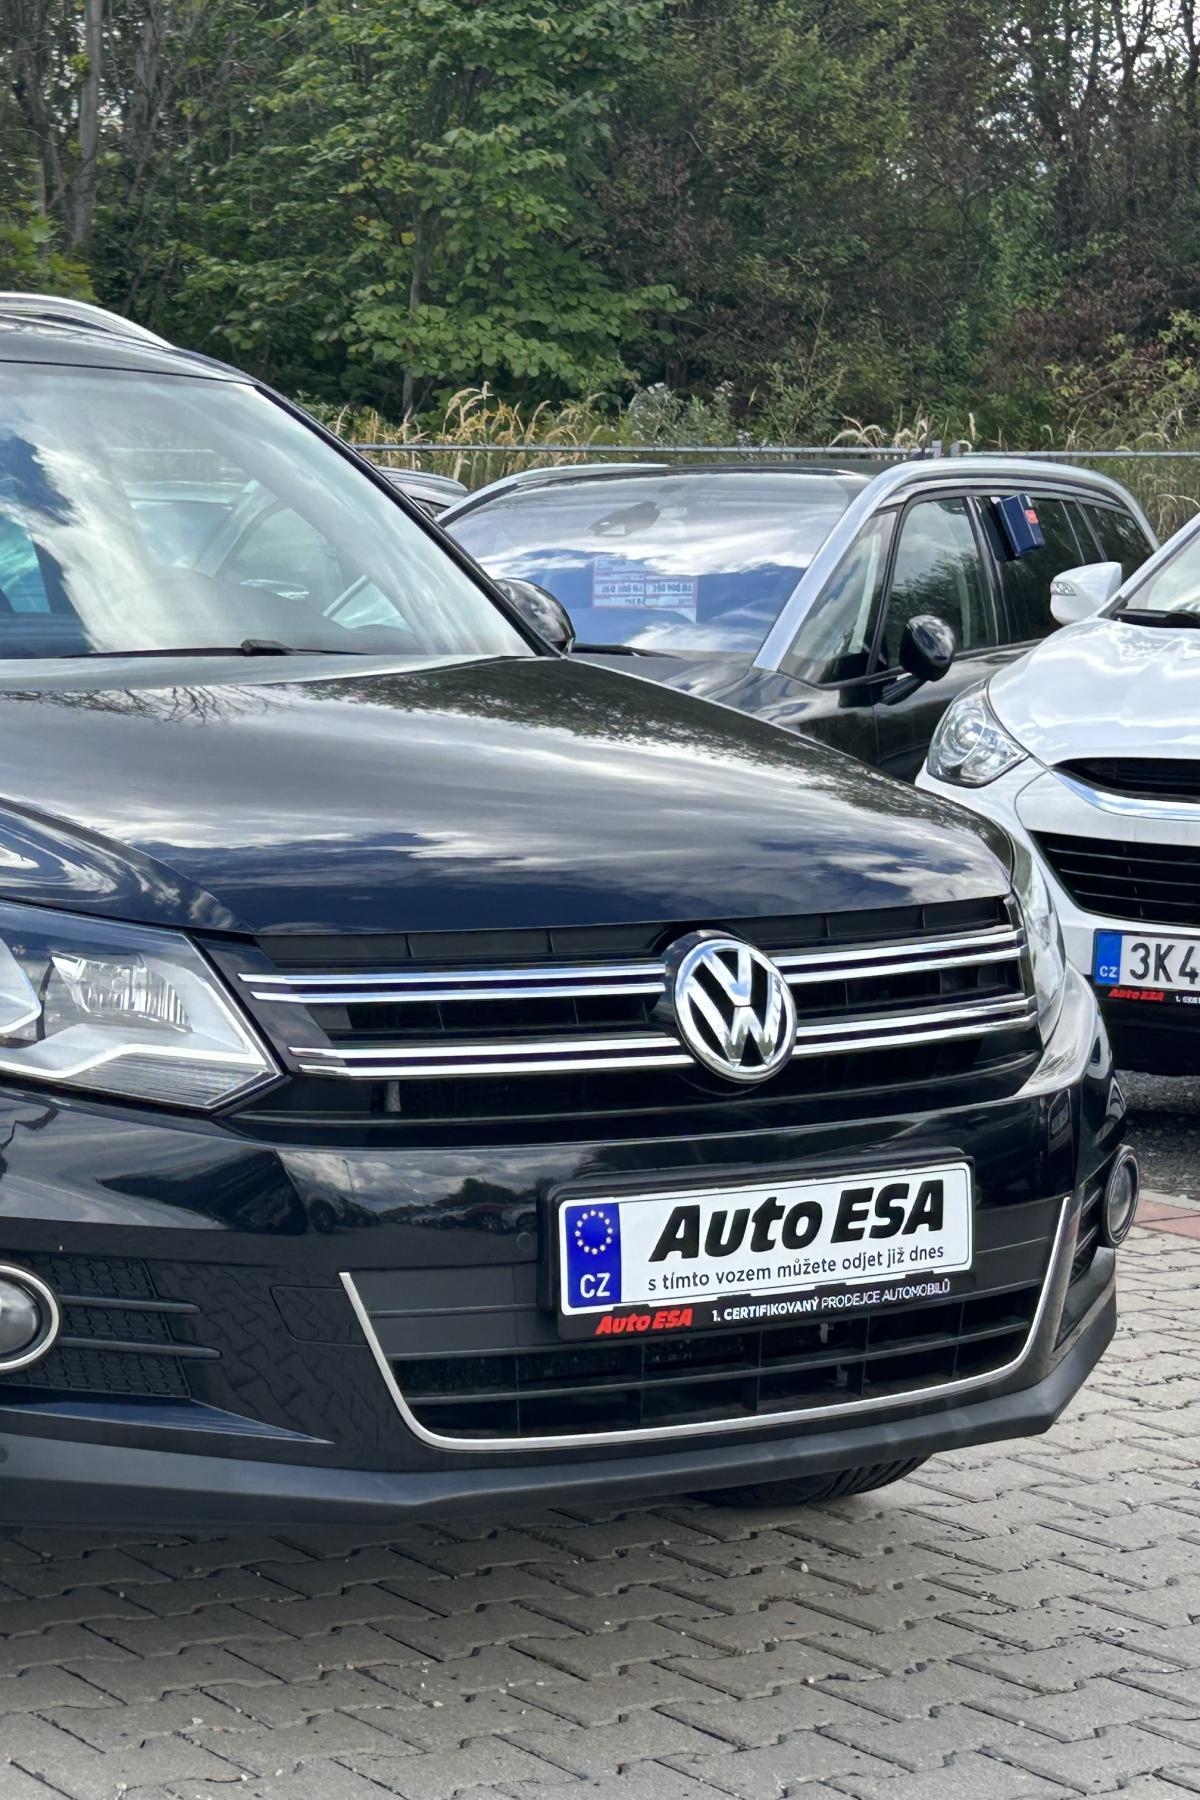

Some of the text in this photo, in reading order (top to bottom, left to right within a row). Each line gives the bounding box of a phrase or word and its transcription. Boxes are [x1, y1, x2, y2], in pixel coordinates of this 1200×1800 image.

[1100, 965, 1119, 978] CZ
[1129, 942, 1199, 985] 3K4
[648, 1178, 944, 1263] Auto ESA
[648, 1278, 657, 1291] s
[662, 1271, 710, 1290] tímto
[715, 1266, 771, 1284] vozem
[777, 1257, 837, 1279] můžete
[842, 1251, 883, 1272] odjet
[909, 1245, 944, 1262] dnes
[580, 1272, 611, 1298] CZ
[821, 1290, 881, 1310] PRODEJCE
[595, 1308, 693, 1335] Auto ESA
